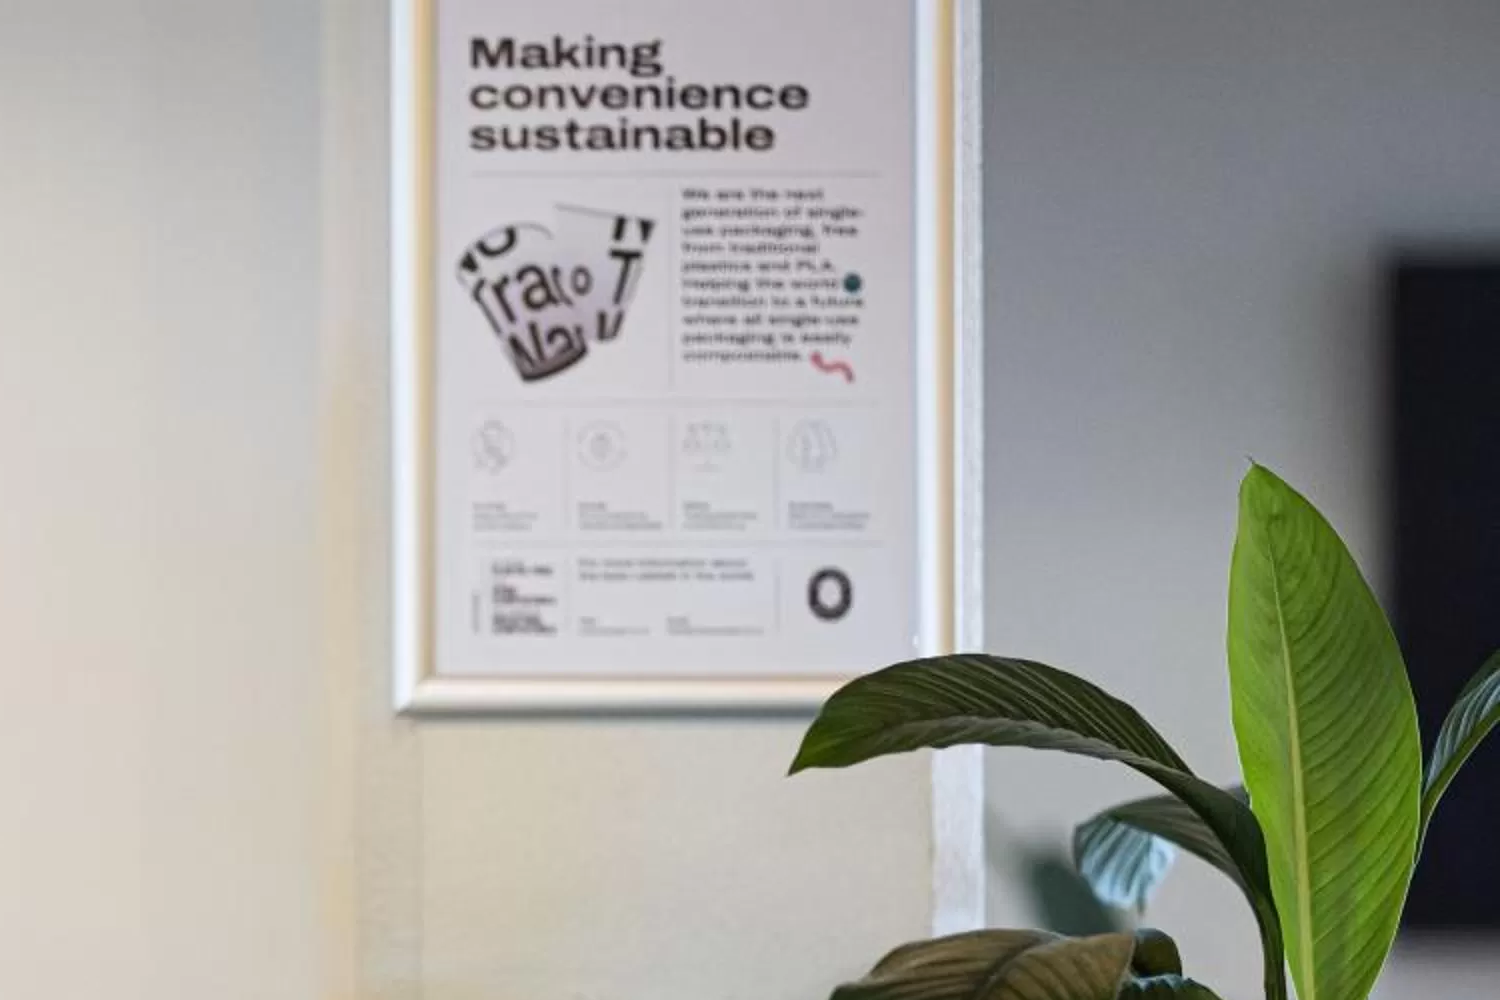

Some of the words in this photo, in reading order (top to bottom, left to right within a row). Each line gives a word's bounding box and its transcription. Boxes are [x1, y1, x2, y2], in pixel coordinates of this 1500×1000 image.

[470, 36, 663, 78] Making
[469, 76, 810, 111] convenience
[469, 118, 775, 152] sustainable
